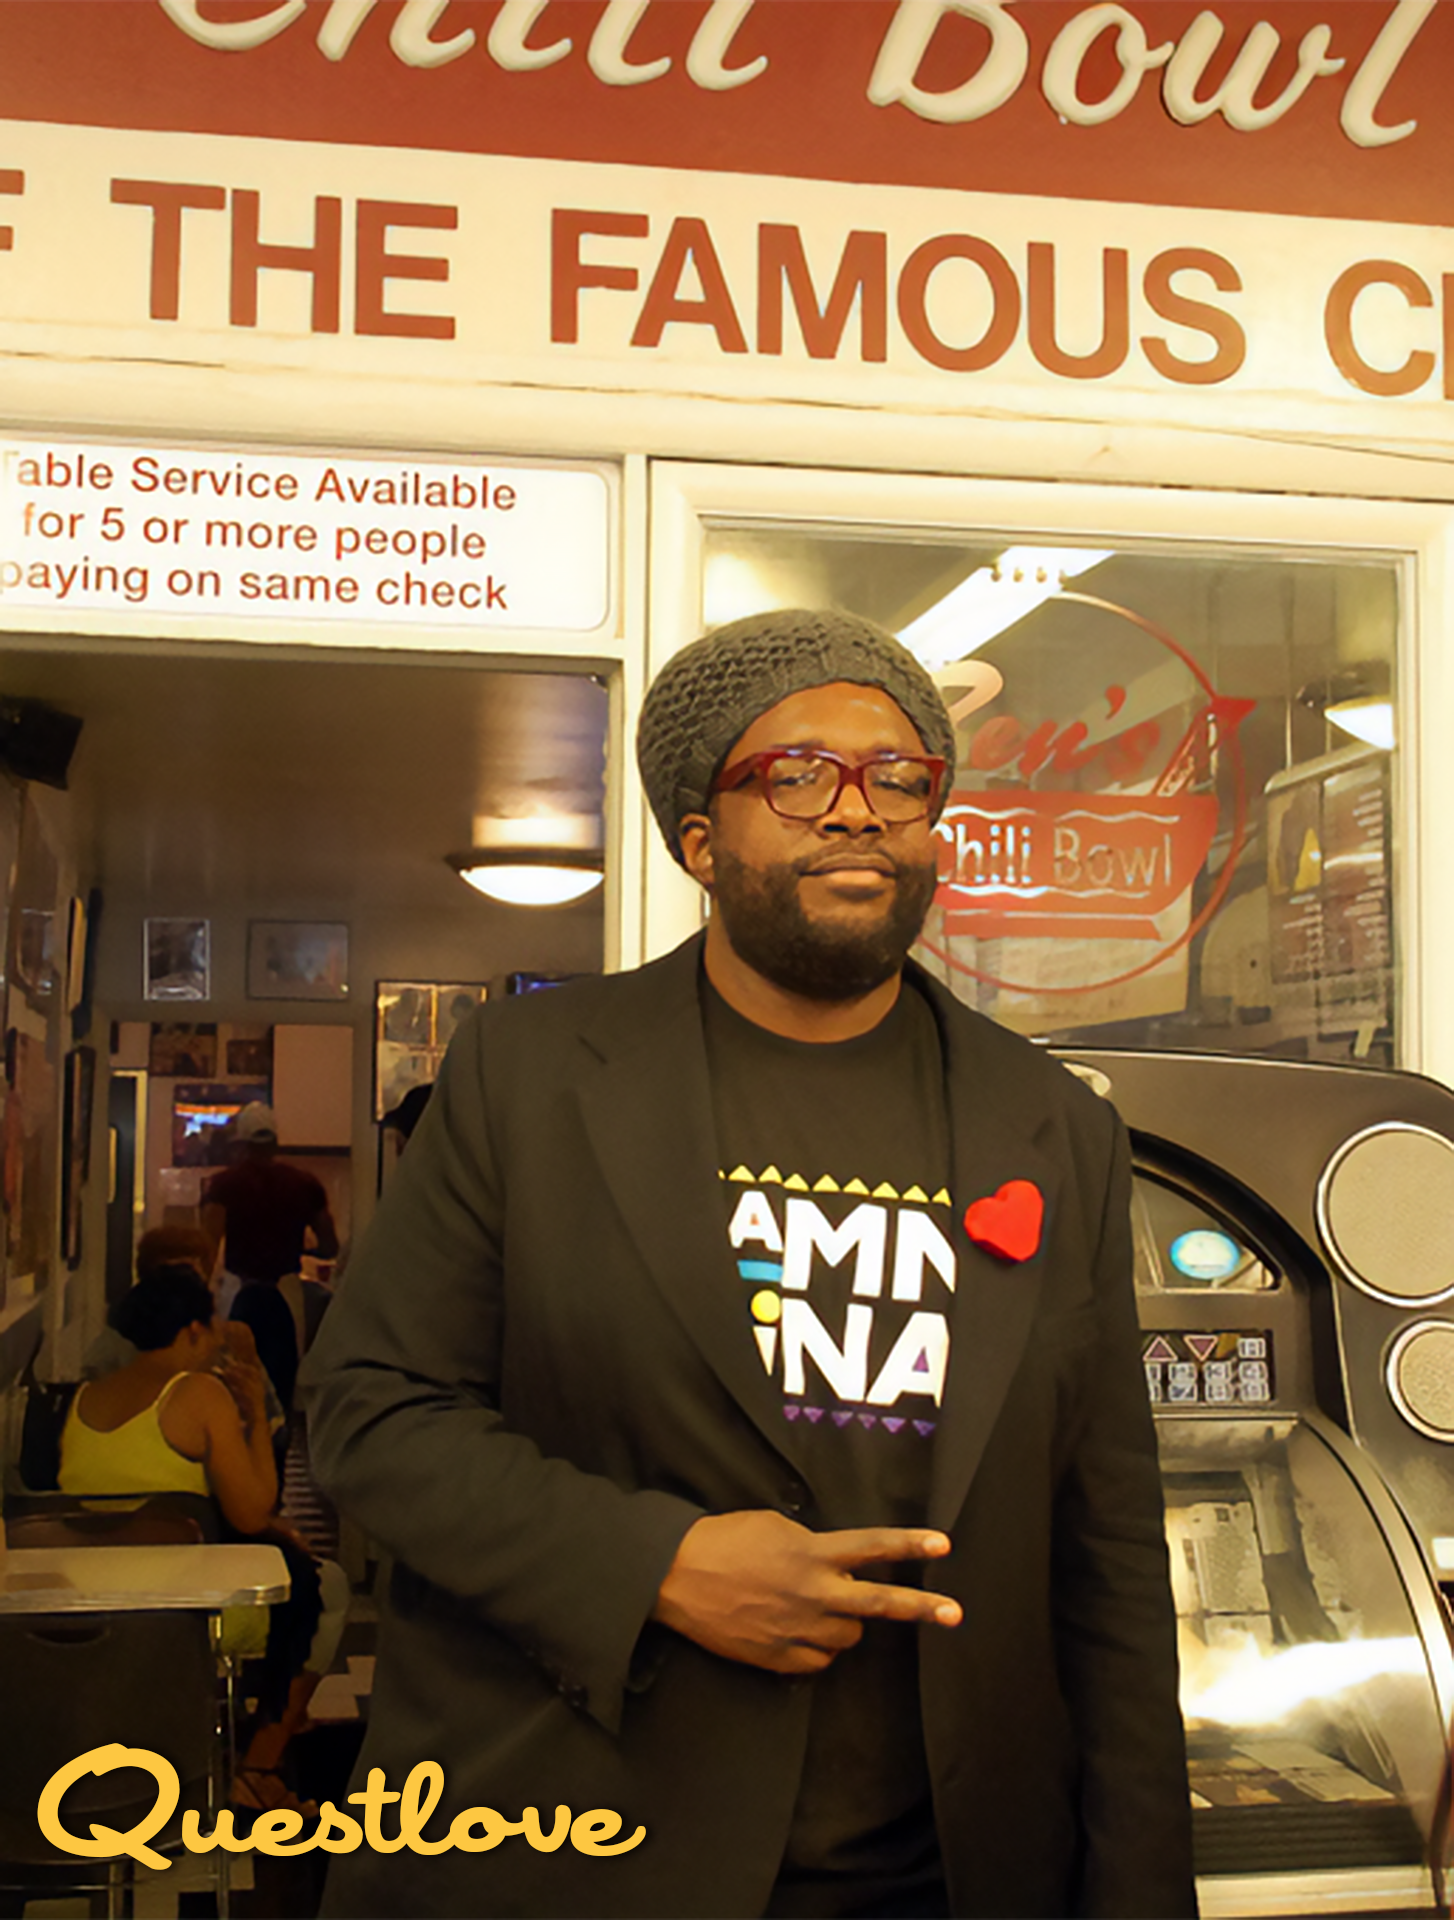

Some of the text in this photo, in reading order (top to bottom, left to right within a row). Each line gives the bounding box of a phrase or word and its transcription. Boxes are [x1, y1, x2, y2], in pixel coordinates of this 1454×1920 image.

[866, 0, 1438, 148] Bowl
[110, 178, 459, 340] THE
[549, 208, 1247, 385] FAMOUS
[1324, 259, 1454, 401] C
[130, 456, 299, 501] Service
[315, 467, 517, 511] Available
[23, 502, 487, 564] for 5 or more people
[0, 556, 508, 610] paying on same check
[1053, 827, 1173, 888] Bowl
